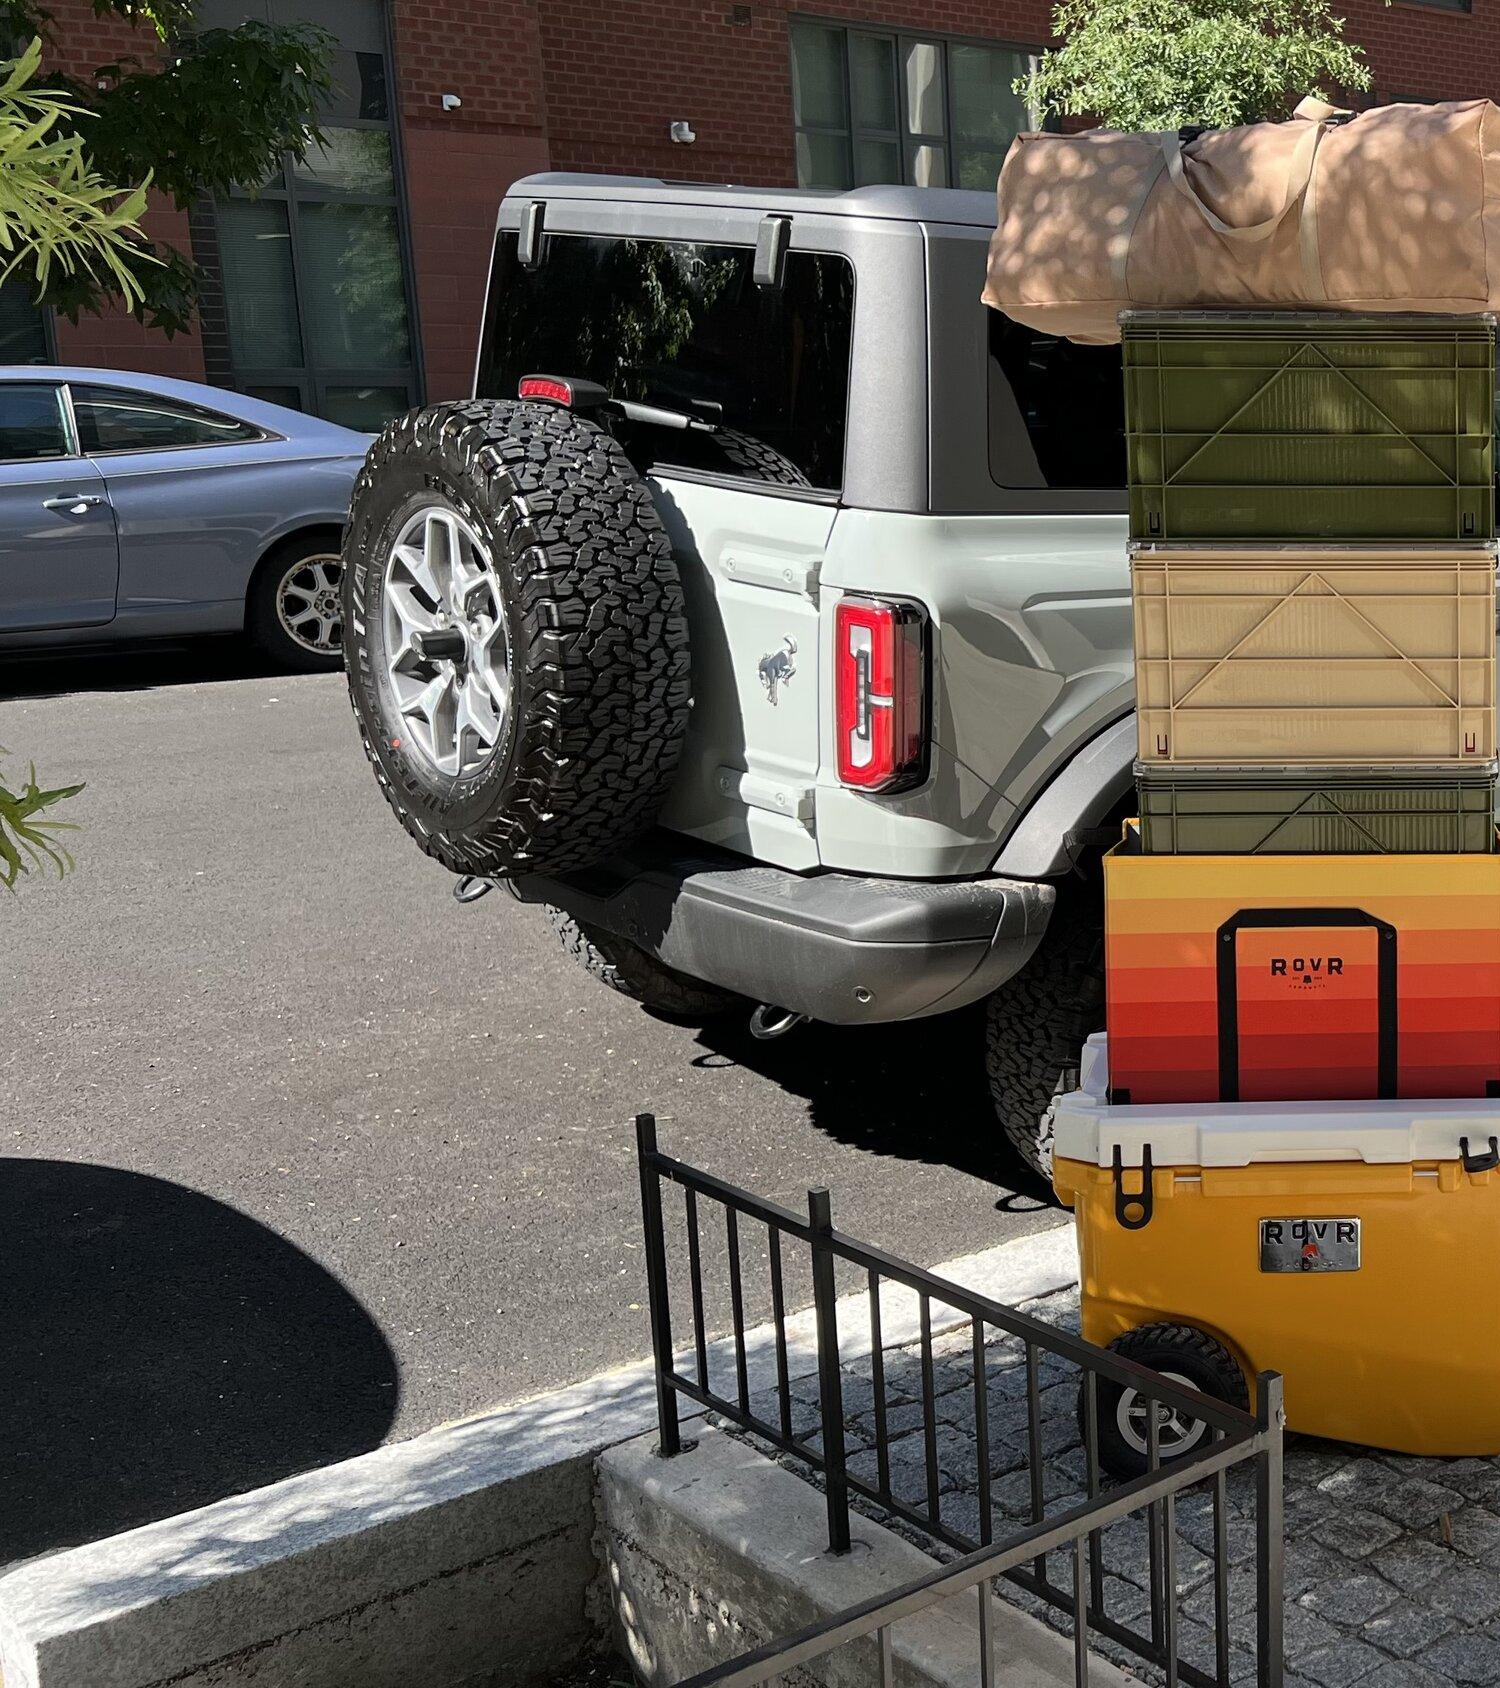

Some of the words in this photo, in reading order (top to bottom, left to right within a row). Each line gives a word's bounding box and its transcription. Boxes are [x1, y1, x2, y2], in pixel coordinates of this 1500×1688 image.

[353, 563, 369, 637] T/A
[1271, 957, 1344, 976] ROVR
[1263, 1221, 1356, 1246] ROVR
